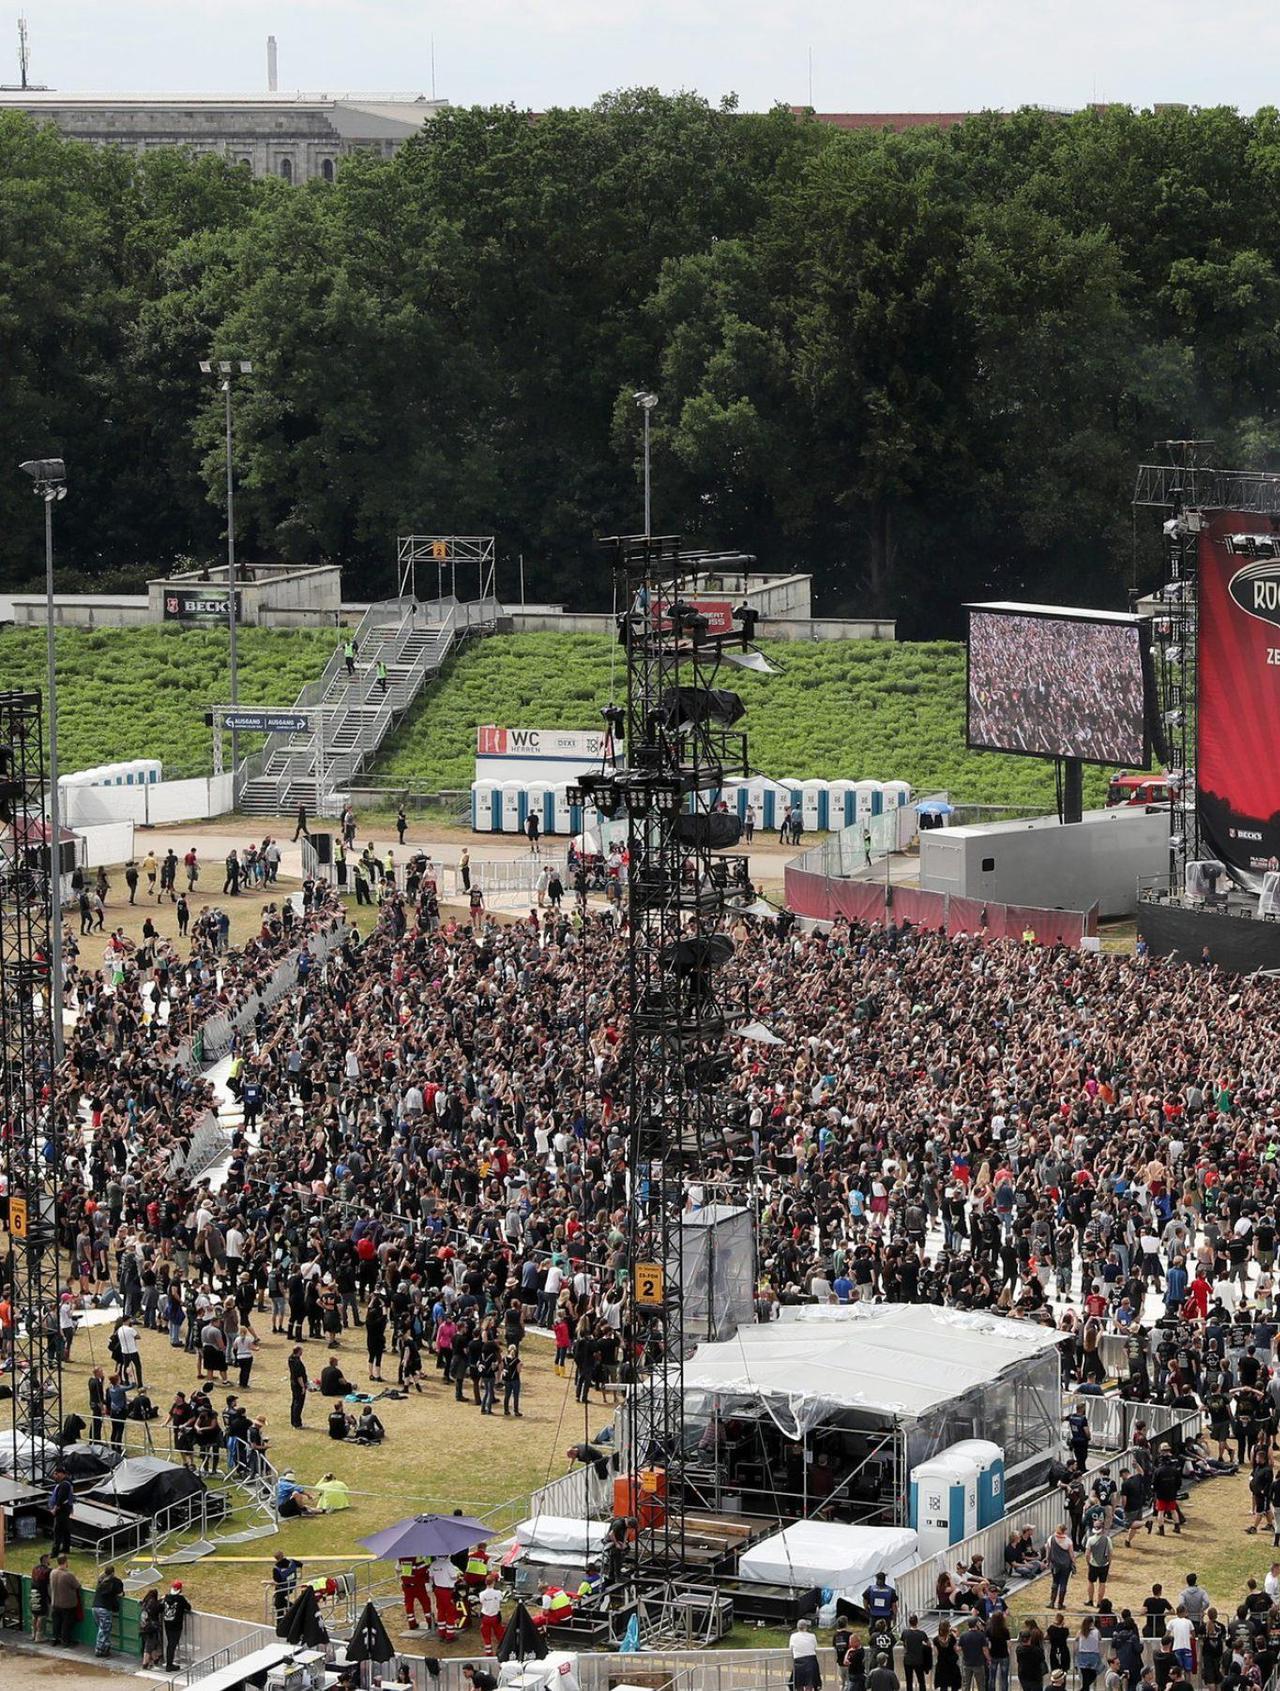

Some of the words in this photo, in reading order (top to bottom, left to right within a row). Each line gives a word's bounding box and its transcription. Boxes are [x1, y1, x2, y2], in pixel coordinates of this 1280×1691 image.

[511, 731, 540, 747] WC
[14, 1214, 22, 1230] 6
[643, 1280, 655, 1297] 2
